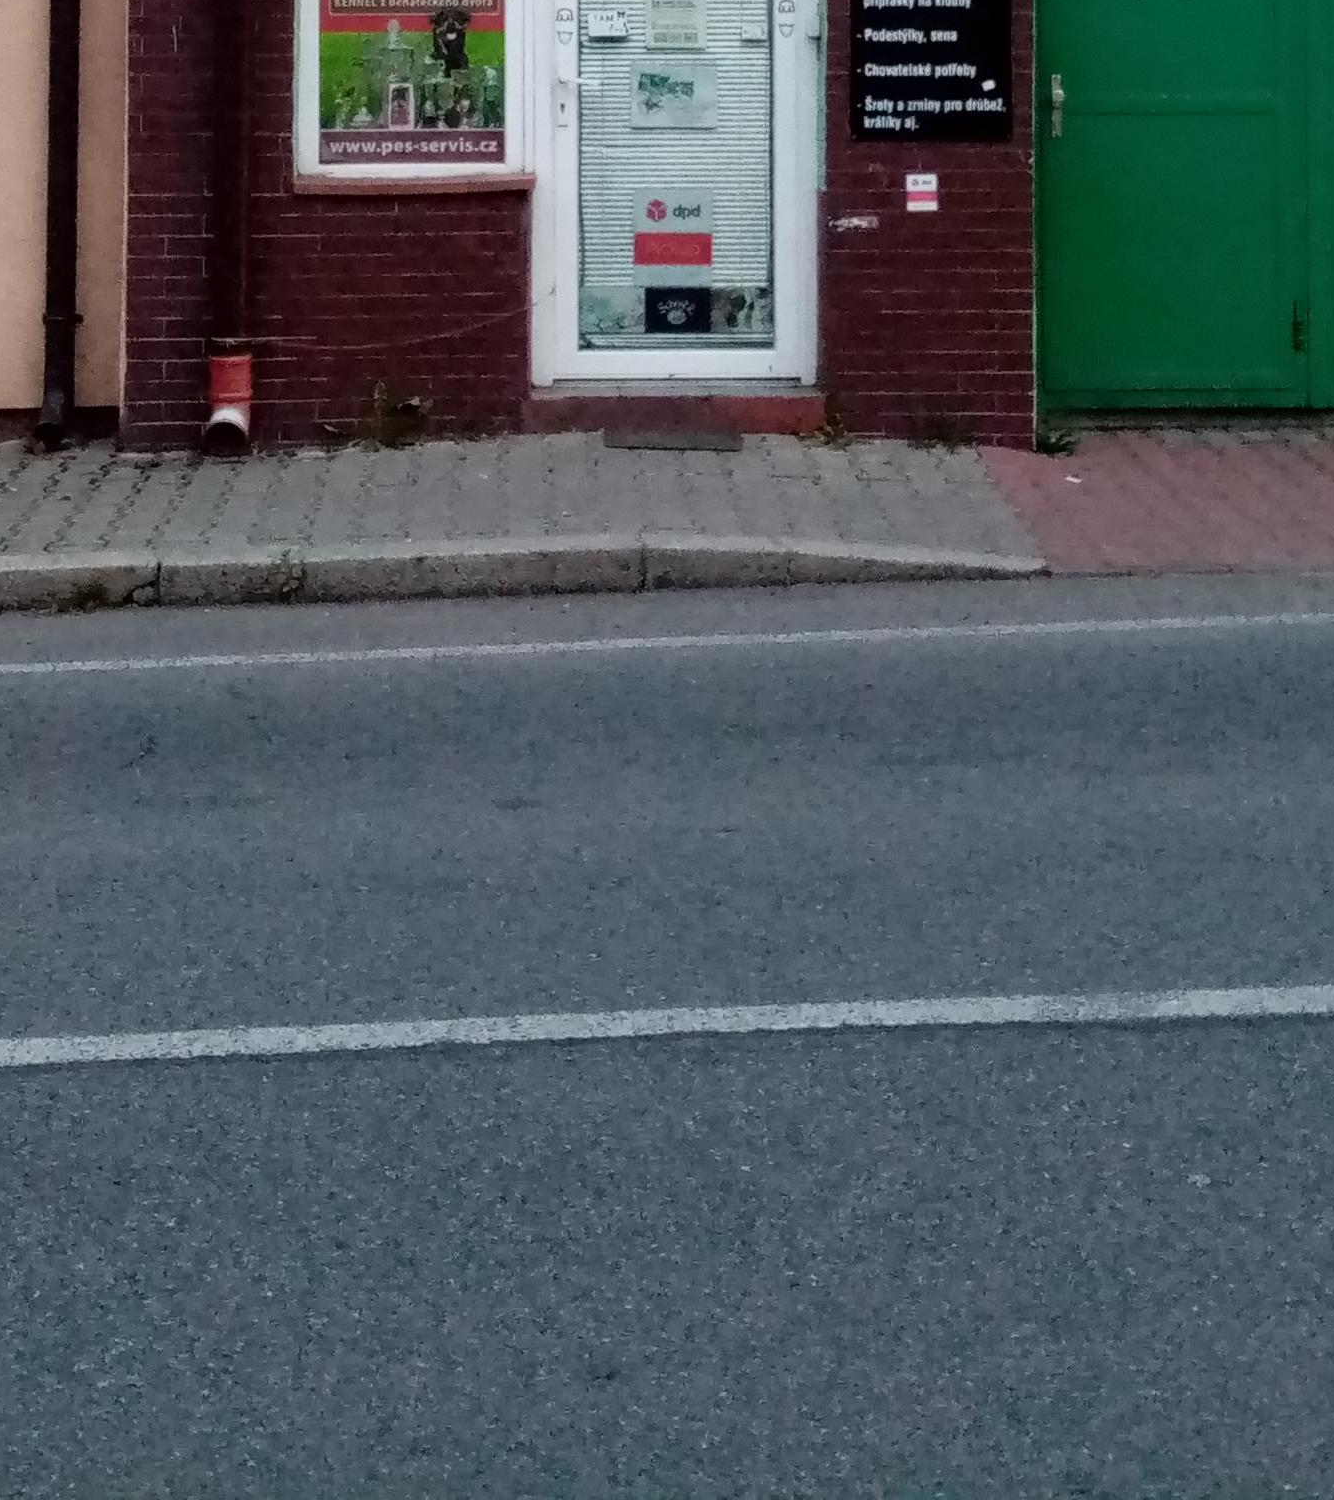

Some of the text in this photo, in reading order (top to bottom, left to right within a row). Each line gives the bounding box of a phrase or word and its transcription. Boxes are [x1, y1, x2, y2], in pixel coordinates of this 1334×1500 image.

[864, 28, 927, 45] Podestýlky,
[930, 31, 958, 42] sena
[864, 62, 932, 77] Chovatelské
[934, 63, 977, 79] potřeby
[896, 100, 904, 112] a
[943, 100, 963, 113] pro
[863, 115, 902, 131] králíky
[330, 138, 498, 156] www.pes-servis.cz
[673, 204, 701, 220] dpd
